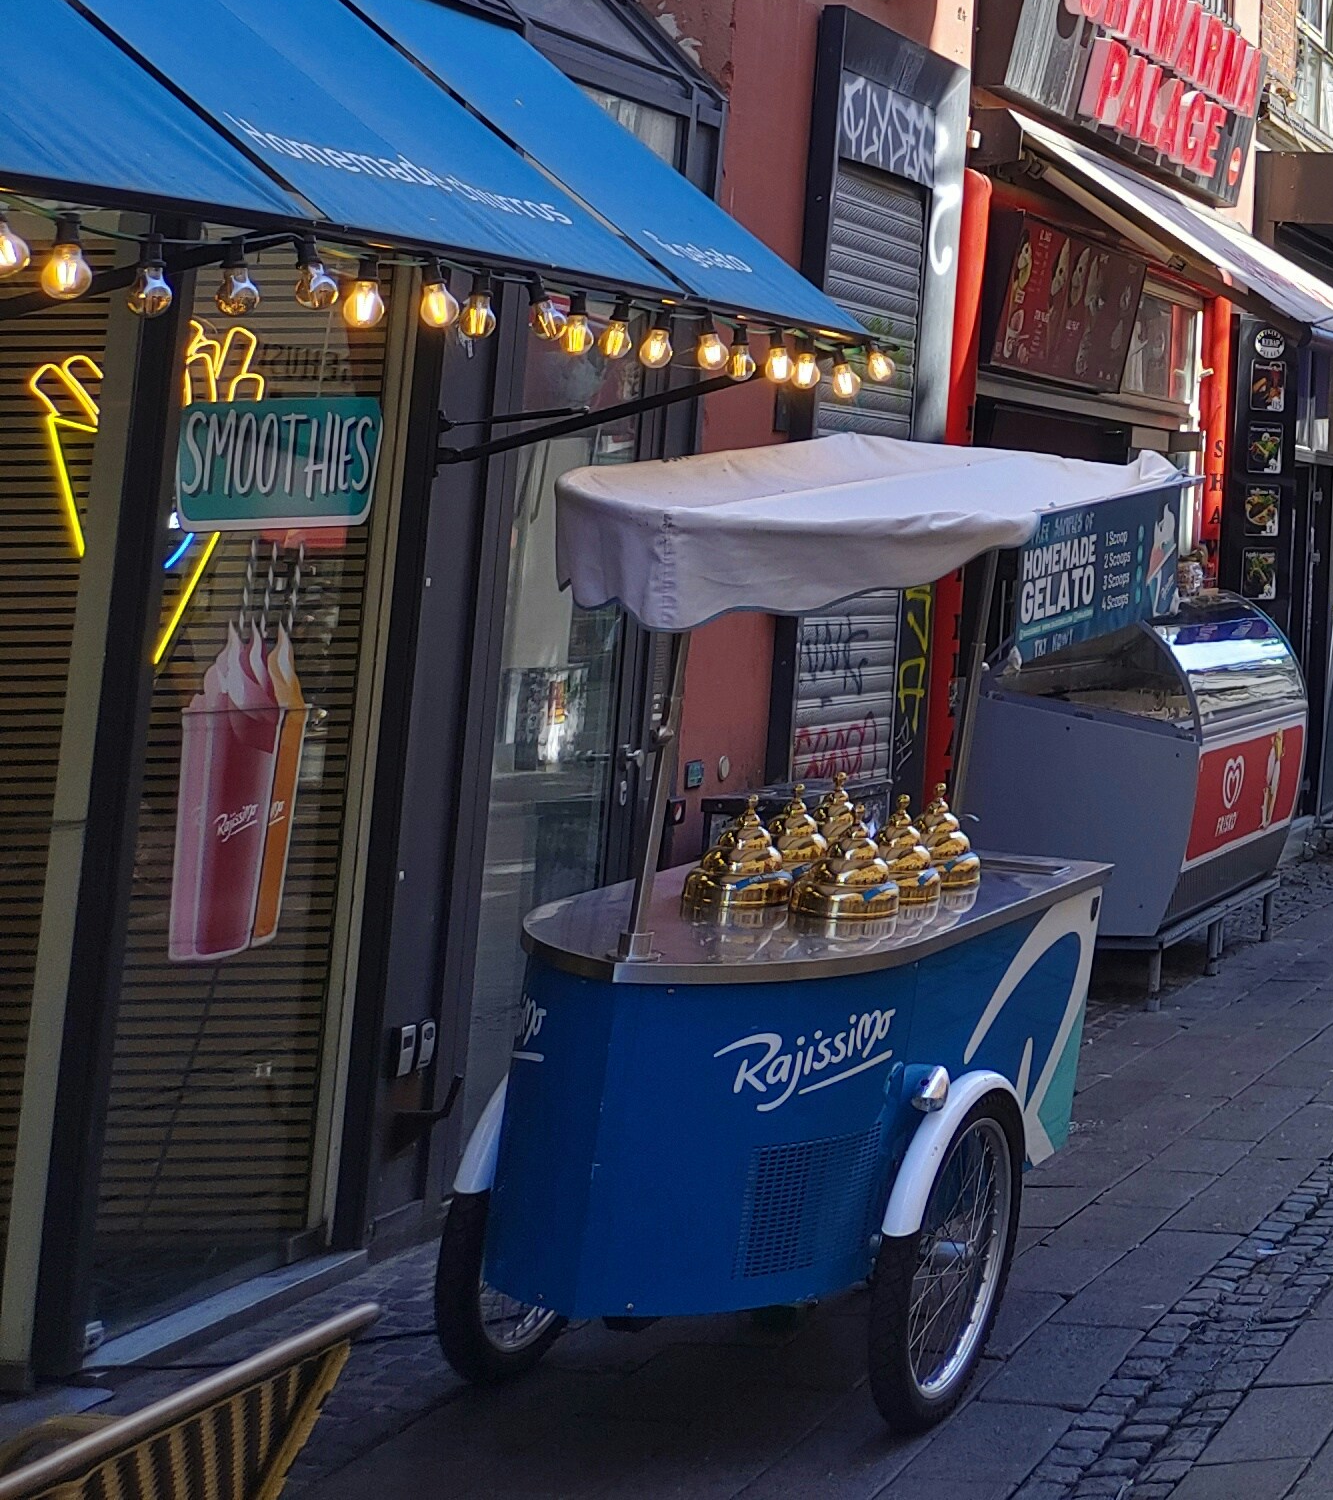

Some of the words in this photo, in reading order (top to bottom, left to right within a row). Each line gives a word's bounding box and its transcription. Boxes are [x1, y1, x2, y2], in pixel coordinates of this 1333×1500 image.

[1080, 37, 1227, 178] PALACE
[223, 111, 453, 193] Homemade
[446, 174, 573, 225] churros
[671, 242, 753, 273] gelato
[182, 409, 373, 498] SMOOTHIES
[1023, 533, 1097, 581] HOMEMADE
[1108, 550, 1132, 567] Scoops
[1108, 571, 1130, 589] Scoops
[1020, 564, 1095, 625] GELATO
[1106, 592, 1129, 610] Scoops
[713, 1008, 896, 1112] Rajissimo
